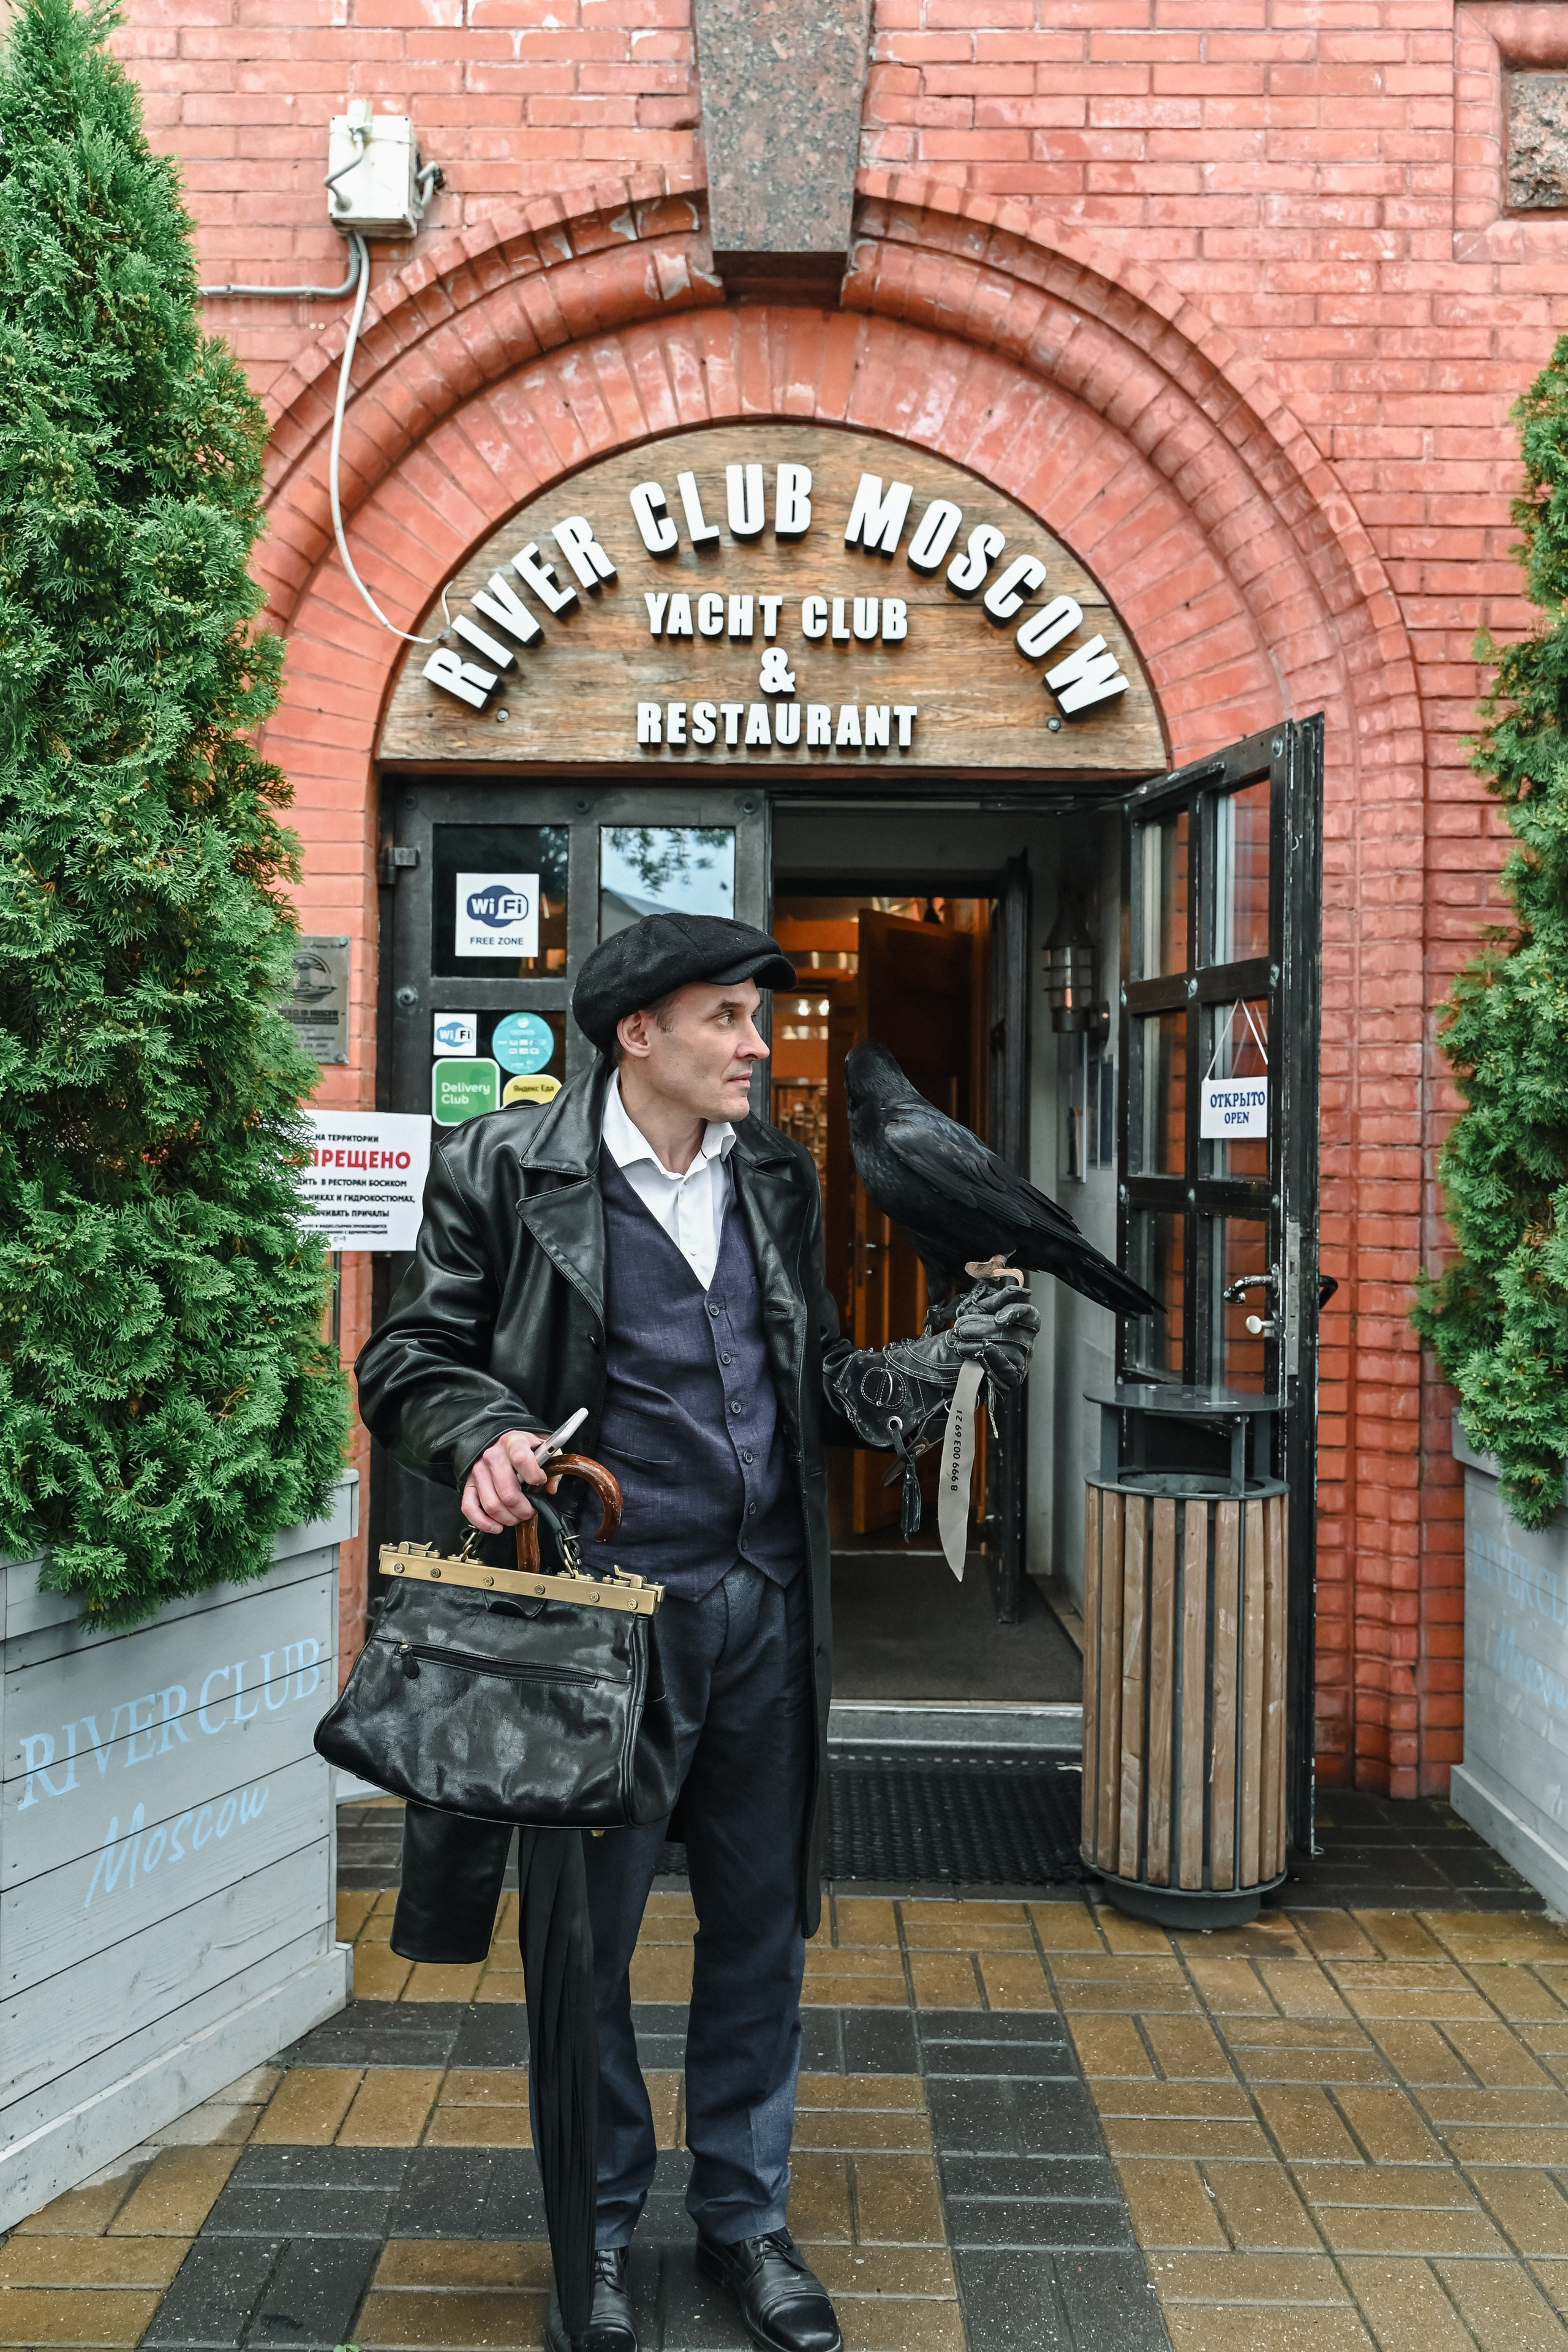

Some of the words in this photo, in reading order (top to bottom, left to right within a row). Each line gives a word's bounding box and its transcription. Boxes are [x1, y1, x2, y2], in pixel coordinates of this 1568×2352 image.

[422, 516, 616, 709] RIVER
[629, 463, 812, 552] CLUB
[844, 473, 1130, 714] MOSCOW
[644, 592, 783, 636] YACHT
[801, 595, 908, 640] CLUB
[760, 647, 796, 693] &
[637, 702, 917, 746] RESTAURANT
[441, 1082, 490, 1095] Delivery
[441, 1094, 469, 1104] Club
[1210, 1091, 1265, 1108] ОТКРЫТО
[1224, 1112, 1250, 1124] OPEN
[956, 1409, 963, 1423] 21
[955, 1424, 962, 1438] 69
[953, 1440, 962, 1460] 003
[951, 1462, 960, 1482] 999
[17, 1684, 191, 1811] RIVER
[198, 1638, 320, 1734] CLUB
[83, 1787, 269, 1908] Moscow
